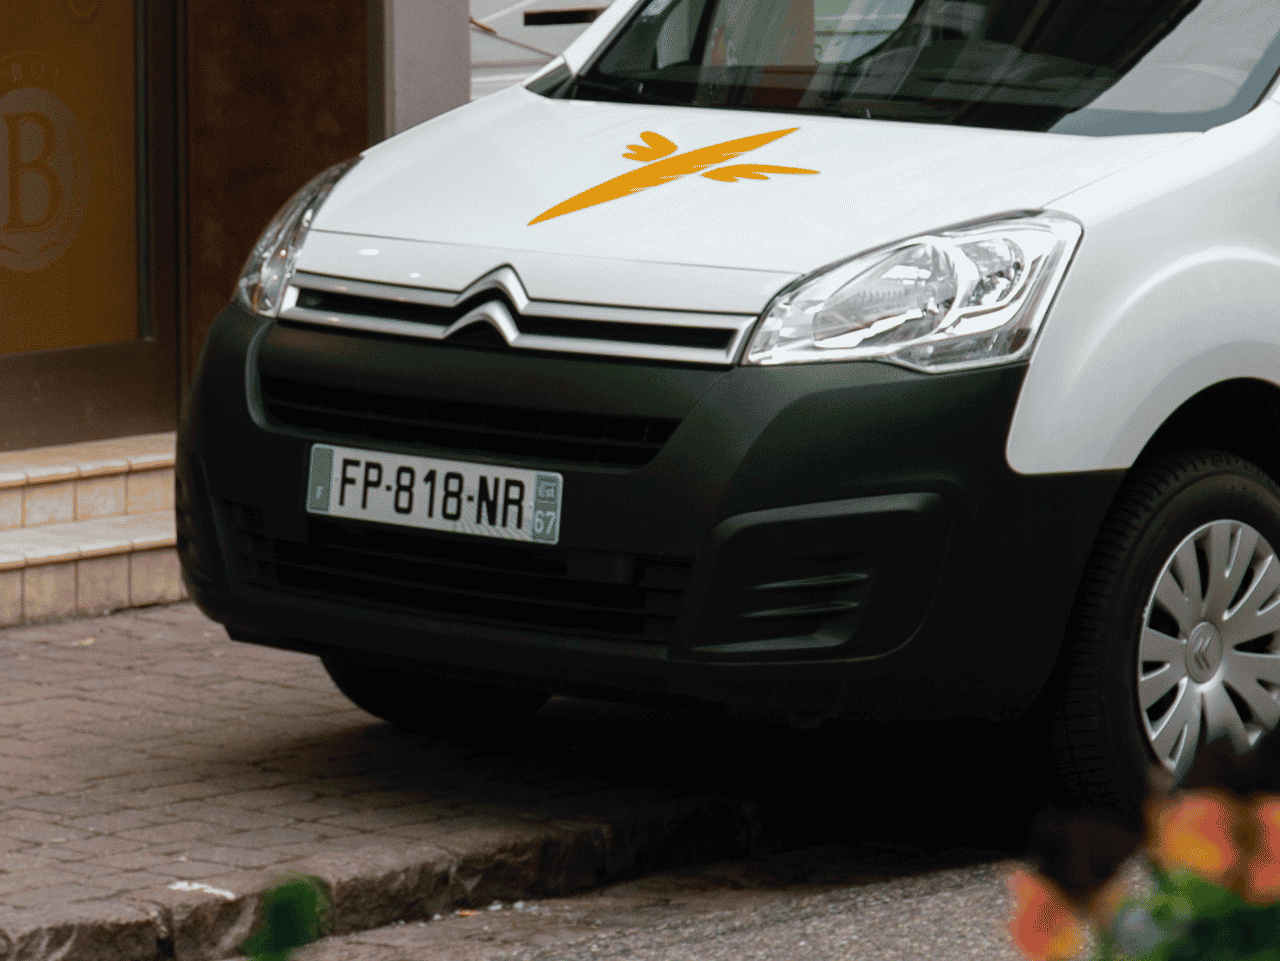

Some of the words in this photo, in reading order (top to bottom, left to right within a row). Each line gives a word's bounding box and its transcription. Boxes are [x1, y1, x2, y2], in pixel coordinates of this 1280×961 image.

[1, 109, 63, 234] B
[338, 457, 526, 530] FP-818-NR
[534, 509, 556, 536] 67
